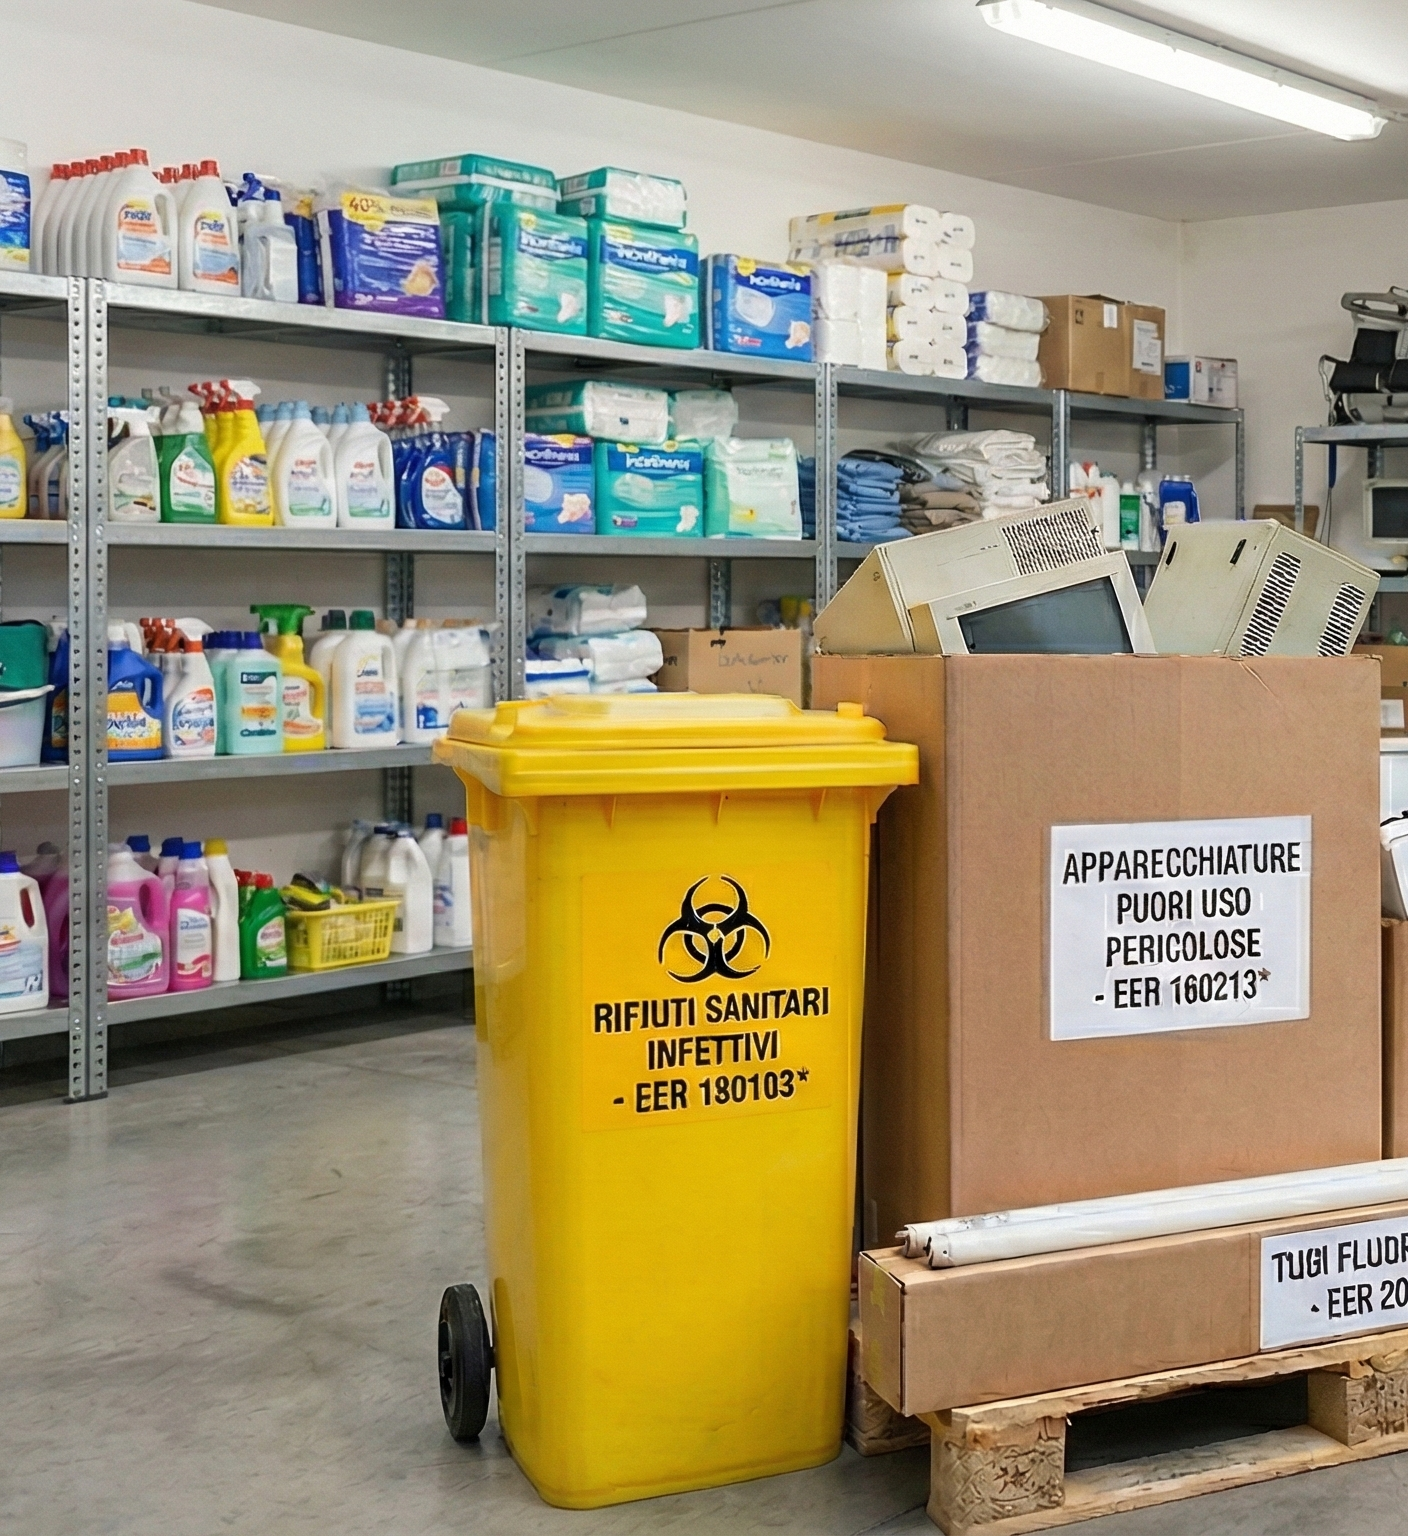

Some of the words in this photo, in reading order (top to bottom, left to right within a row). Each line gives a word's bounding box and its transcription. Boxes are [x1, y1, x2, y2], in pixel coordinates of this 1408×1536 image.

[1063, 842, 1301, 884] APPARECCHIATURE
[1202, 887, 1251, 918] USO
[1106, 928, 1261, 967] PERICOLOSE
[595, 997, 695, 1033] RIFIUTI
[706, 987, 829, 1023] SANITARI
[1114, 977, 1160, 1009] EER
[648, 1030, 778, 1070] INFETTIVI
[636, 1079, 687, 1113] EER
[1327, 1284, 1373, 1320] EER
